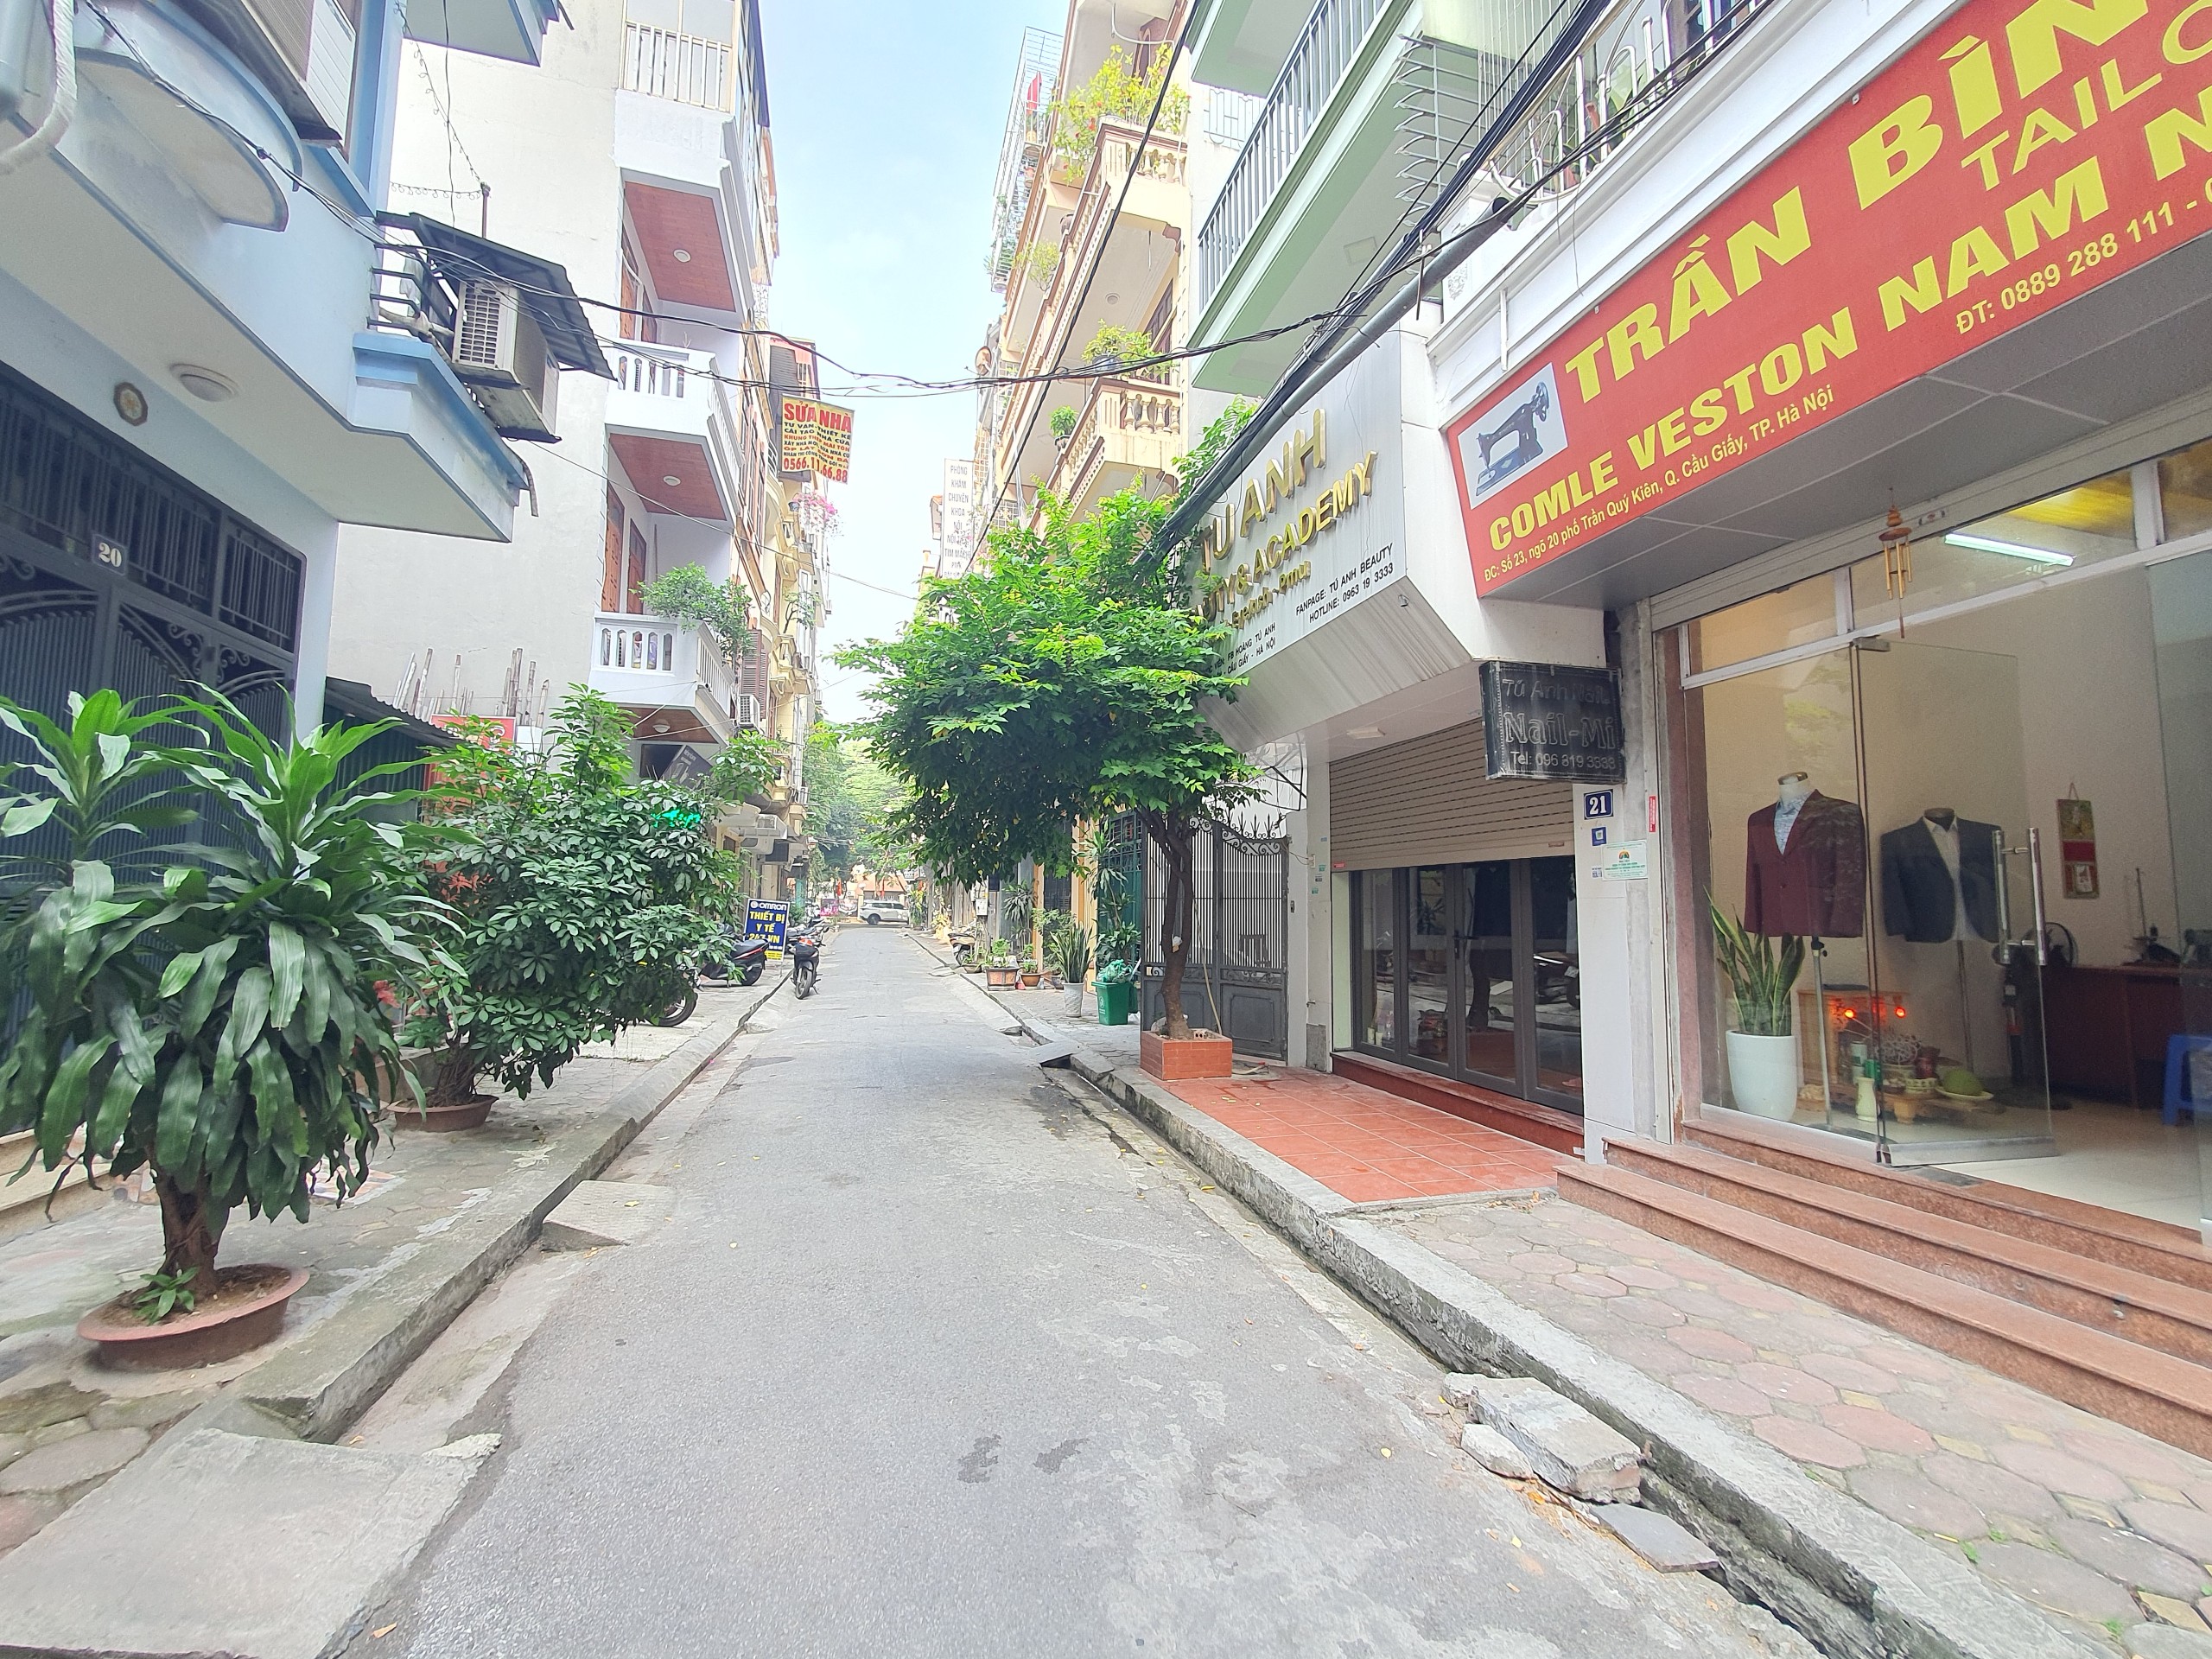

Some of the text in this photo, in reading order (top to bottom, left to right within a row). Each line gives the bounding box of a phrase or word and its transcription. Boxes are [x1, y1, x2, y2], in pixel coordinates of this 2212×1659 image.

[1565, 186, 1812, 404] TRẦN
[1955, 302, 1996, 334] ĐT:
[2000, 264, 2061, 310] 0889
[2069, 232, 2119, 276] 288
[2126, 201, 2174, 243] 111
[1489, 450, 1618, 551] COMLE
[1627, 307, 1858, 471] VESTON
[1878, 156, 2109, 332] NAM
[784, 400, 852, 432] SỬA NHÀ
[1240, 408, 1326, 537] ANH
[1484, 385, 1834, 582] ĐC: Số 23, ngõ 20 phố Trần Quý Kiên, Q. Cầu Giấy, TP. Hà Nội
[1253, 450, 1378, 584] ACADEMY
[99, 542, 122, 568] 20
[1295, 543, 1393, 616] FANPAGE: TÚ ANH BEAUTY
[1309, 563, 1393, 623] HOTLINE: 0963 19 3333
[1264, 622, 1276, 638] ANH
[1510, 751, 1532, 766] Tel:
[1589, 795, 1607, 815] 21
[749, 910, 785, 924] THIẾT BỊ
[756, 922, 777, 933] Y TẾ
